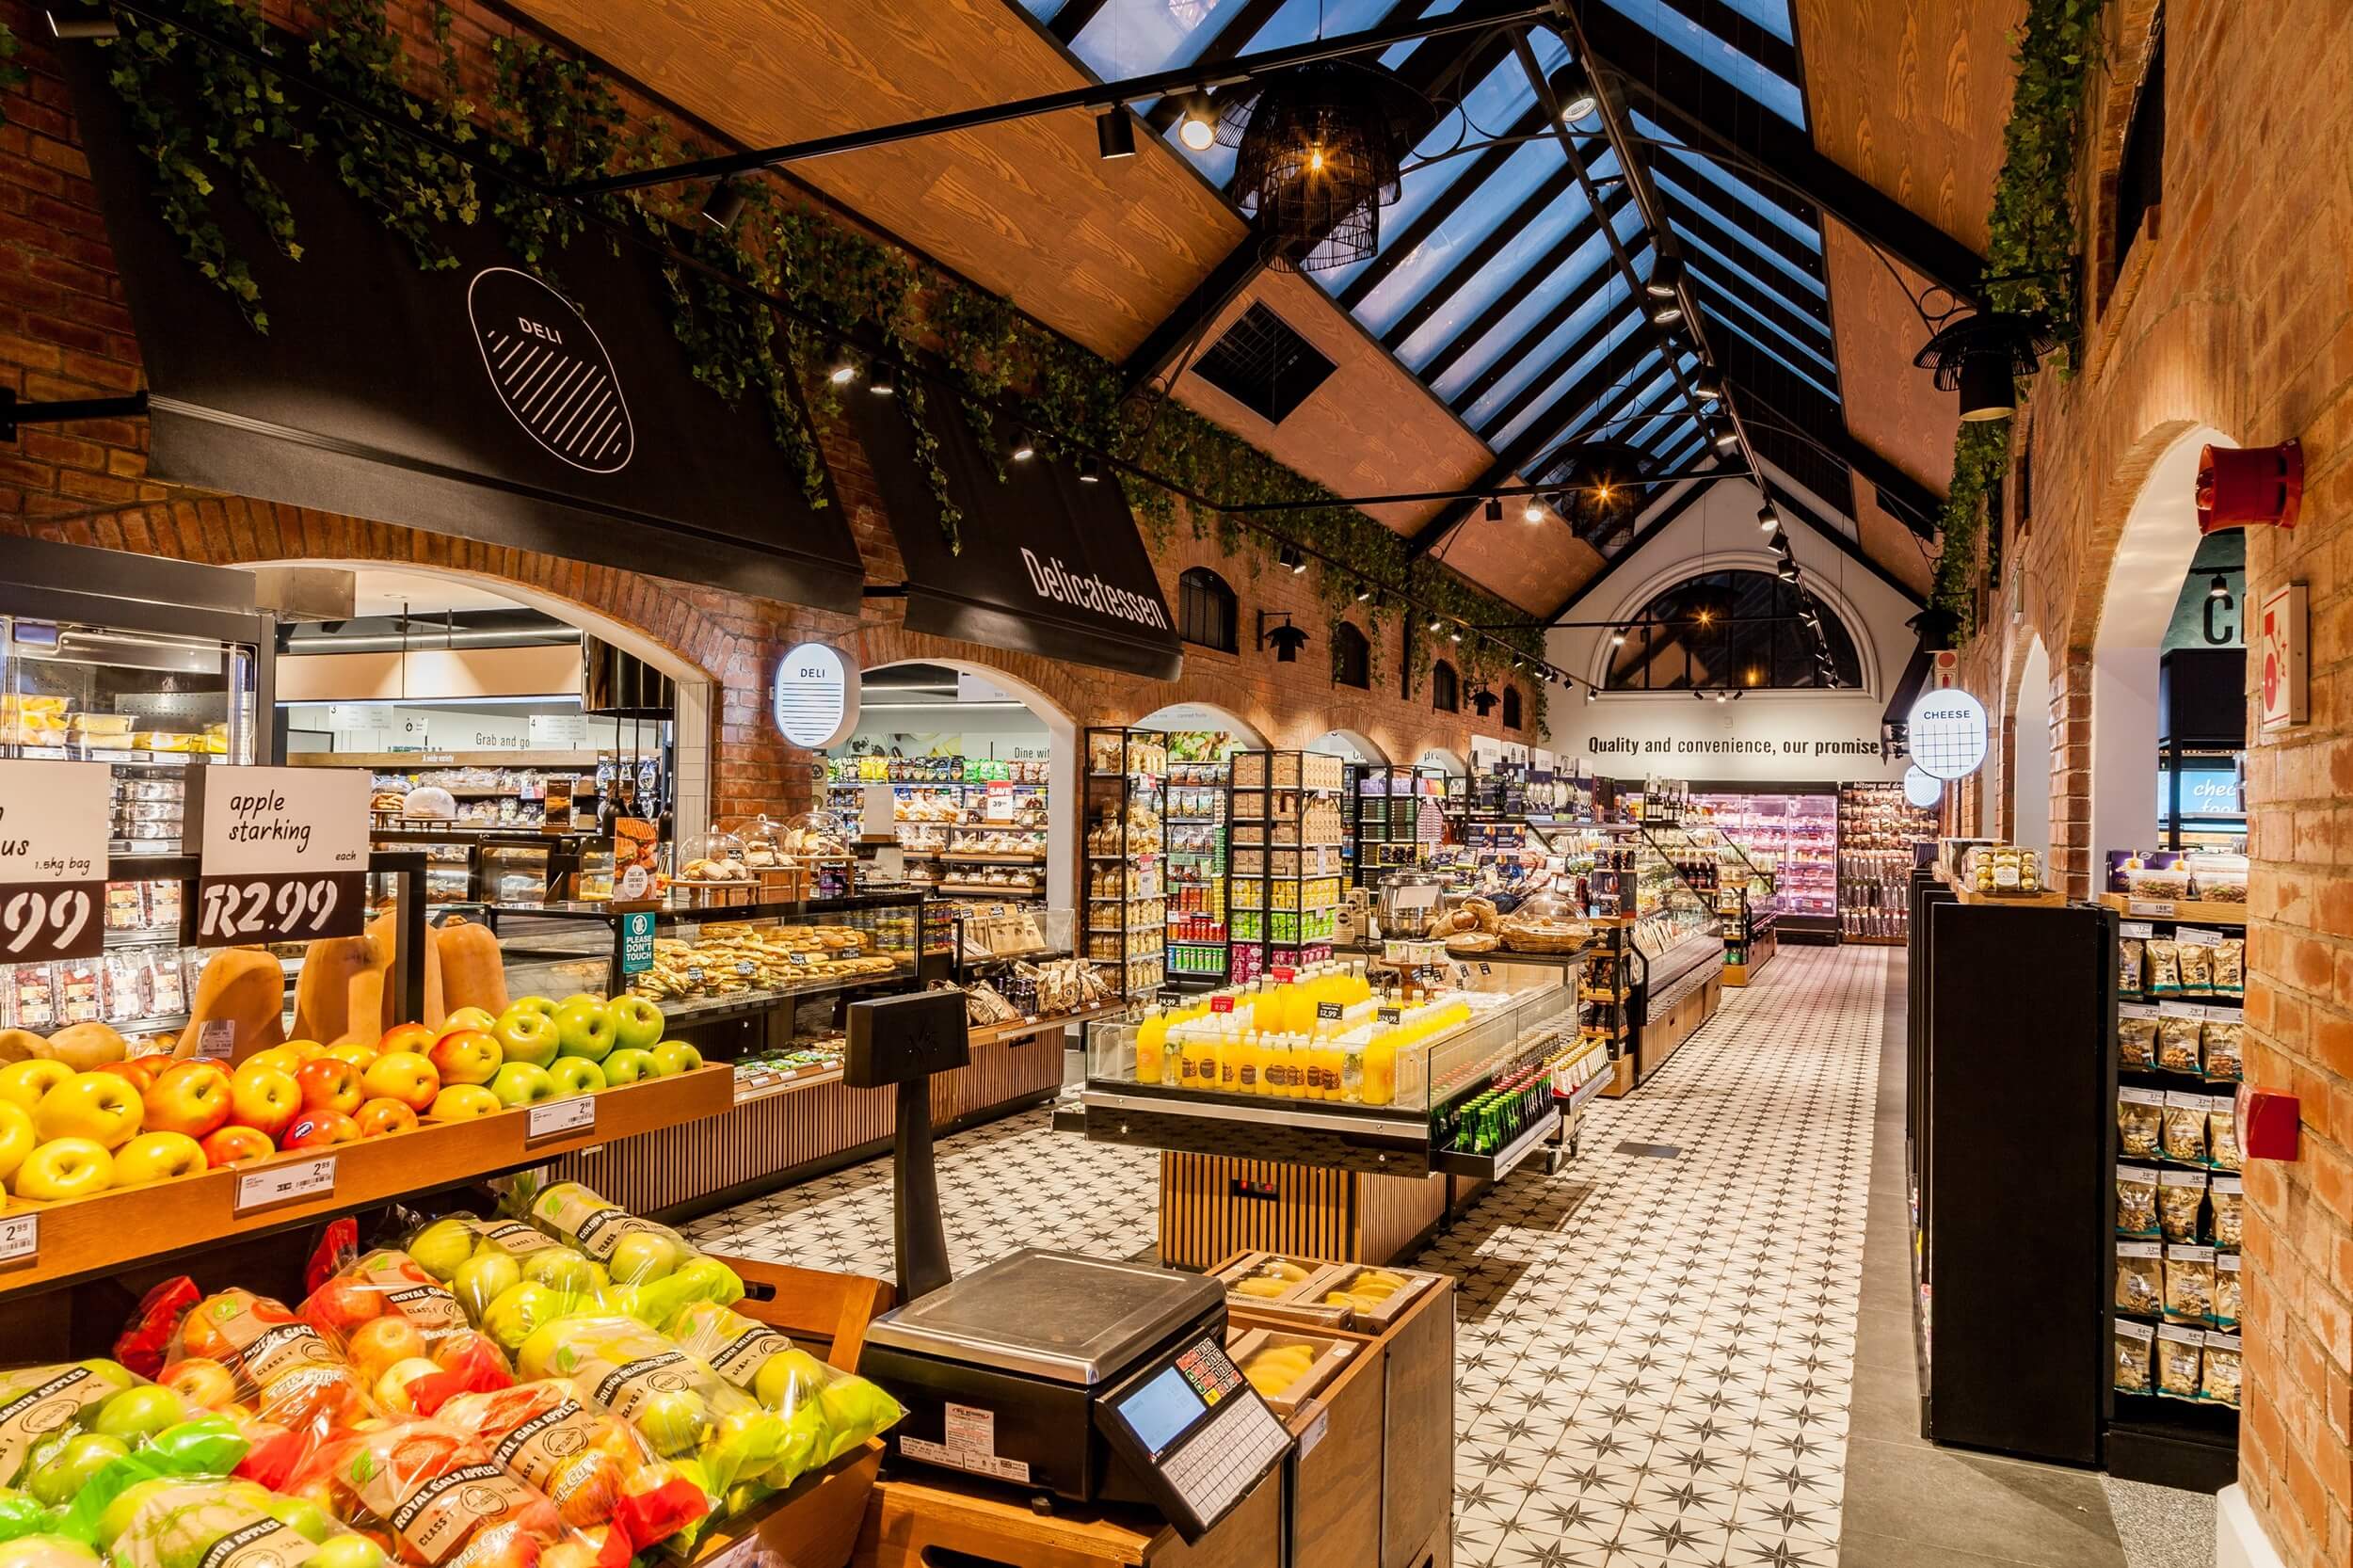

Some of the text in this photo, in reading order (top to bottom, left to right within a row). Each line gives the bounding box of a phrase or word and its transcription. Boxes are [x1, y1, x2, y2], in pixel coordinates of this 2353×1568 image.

[519, 317, 562, 344] DELI
[1020, 547, 1168, 630] Delicatessen
[800, 668, 825, 679] DELI
[531, 719, 536, 728] 4
[1924, 711, 1971, 719] CHEESE
[475, 732, 530, 750] Grab and go
[1589, 737, 1880, 756] Quality and convenience, our promise
[1015, 747, 1033, 759] Dine
[989, 787, 1013, 795] SAVE
[230, 789, 285, 820] apple
[229, 819, 311, 853] starking
[35, 857, 90, 876] 1.5kg bag
[335, 852, 357, 861] each
[201, 880, 338, 938] R2.99
[626, 936, 652, 944] PLEASE
[626, 943, 652, 952] DON'T
[626, 952, 652, 961] TOUCH
[579, 1216, 603, 1240] GOLDEN
[507, 1240, 530, 1248] CLASS
[598, 1233, 617, 1253] CLASS
[390, 1288, 428, 1302] ROYAL
[256, 1356, 285, 1377] CLASS
[712, 1348, 738, 1368] GOLDEN
[38, 1369, 88, 1397] APPLES
[622, 1394, 640, 1419] CLASS
[513, 1419, 546, 1442] GALA
[541, 1400, 581, 1424] APPLES
[394, 1464, 500, 1529] ROYAL GALA APPLES
[233, 1520, 281, 1544] APPLES
[418, 1517, 447, 1546] CLASS
